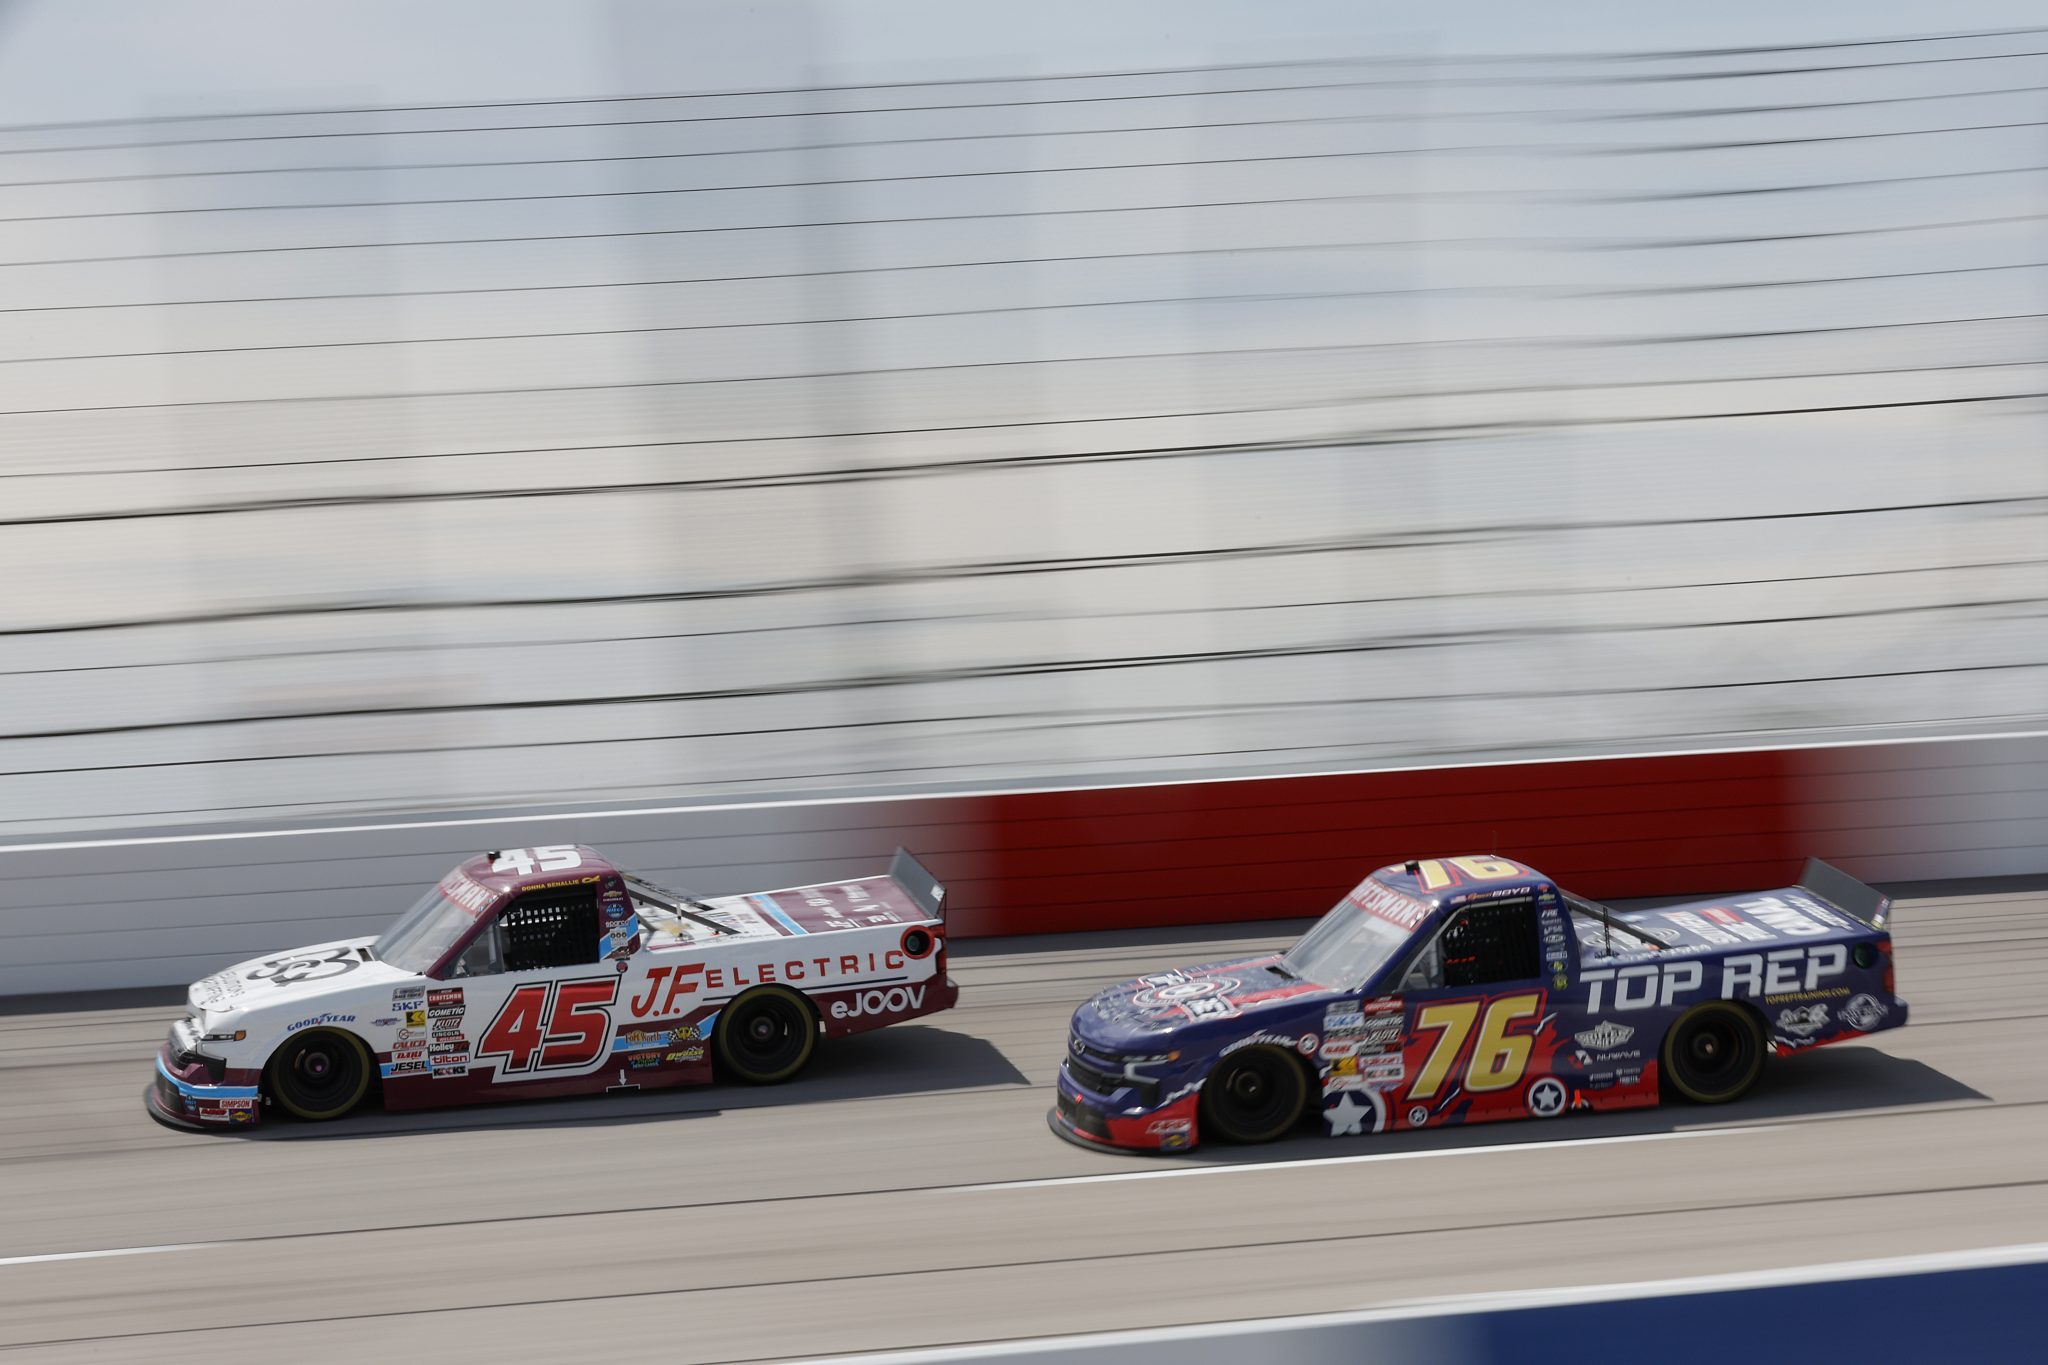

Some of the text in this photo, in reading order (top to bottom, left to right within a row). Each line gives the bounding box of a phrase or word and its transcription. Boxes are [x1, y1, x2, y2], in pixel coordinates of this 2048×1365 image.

[491, 844, 582, 876] 45
[1389, 854, 1521, 890] 76
[521, 879, 580, 892] DONNA BENALLIE
[1492, 886, 1531, 898] BOYD
[705, 950, 904, 989] ELECTRIC
[1579, 943, 1848, 1014] TOP REP
[429, 993, 462, 1002] CRAFTSMAN
[392, 1000, 424, 1011] SKF
[429, 1007, 465, 1017] COMETIC
[287, 1013, 356, 1031] GOODYEAR
[435, 1018, 461, 1026] KLOTZ
[477, 975, 620, 1075] 45
[432, 1030, 460, 1038] LINCOLN
[392, 1040, 427, 1049] CALICO
[429, 1043, 454, 1052] Holley
[1405, 992, 1541, 1101] 76
[432, 1055, 468, 1063] tilton
[391, 1061, 427, 1071] JESEL
[221, 1100, 250, 1108] SIMPSON
